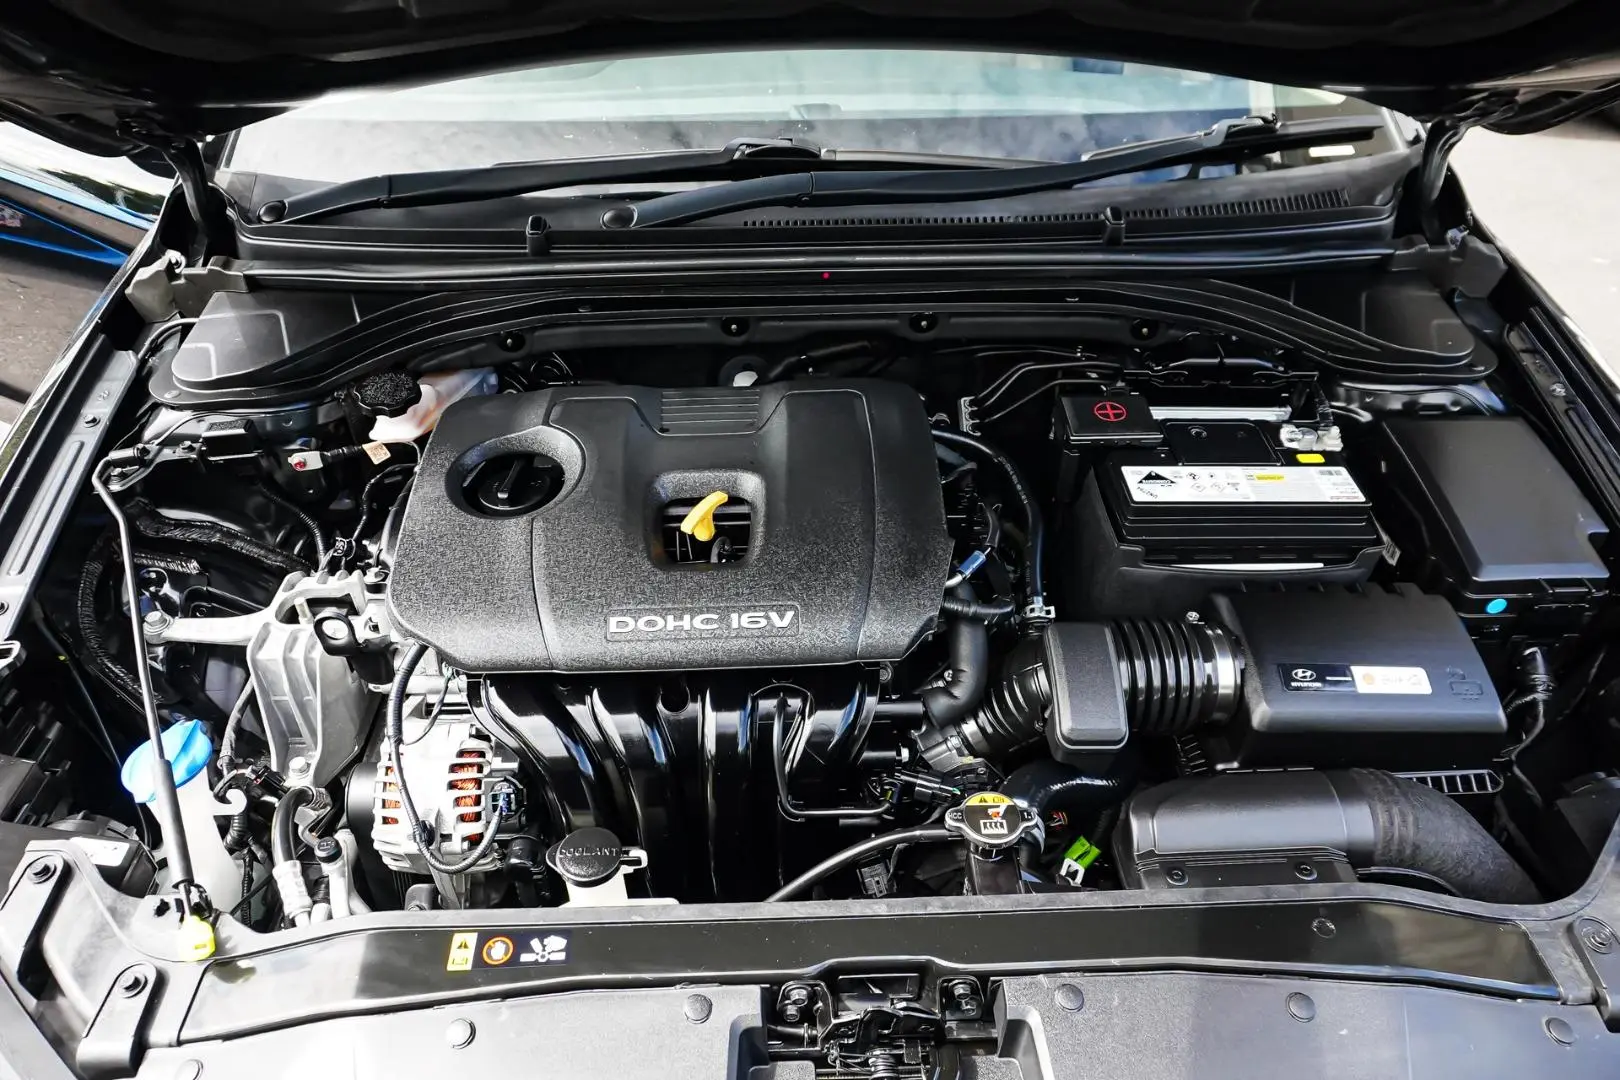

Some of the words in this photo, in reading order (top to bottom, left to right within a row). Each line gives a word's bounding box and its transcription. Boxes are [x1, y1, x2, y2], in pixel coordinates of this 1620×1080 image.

[609, 614, 719, 633] DOHC
[730, 611, 795, 629] 16V
[558, 847, 617, 857] COOLANT
